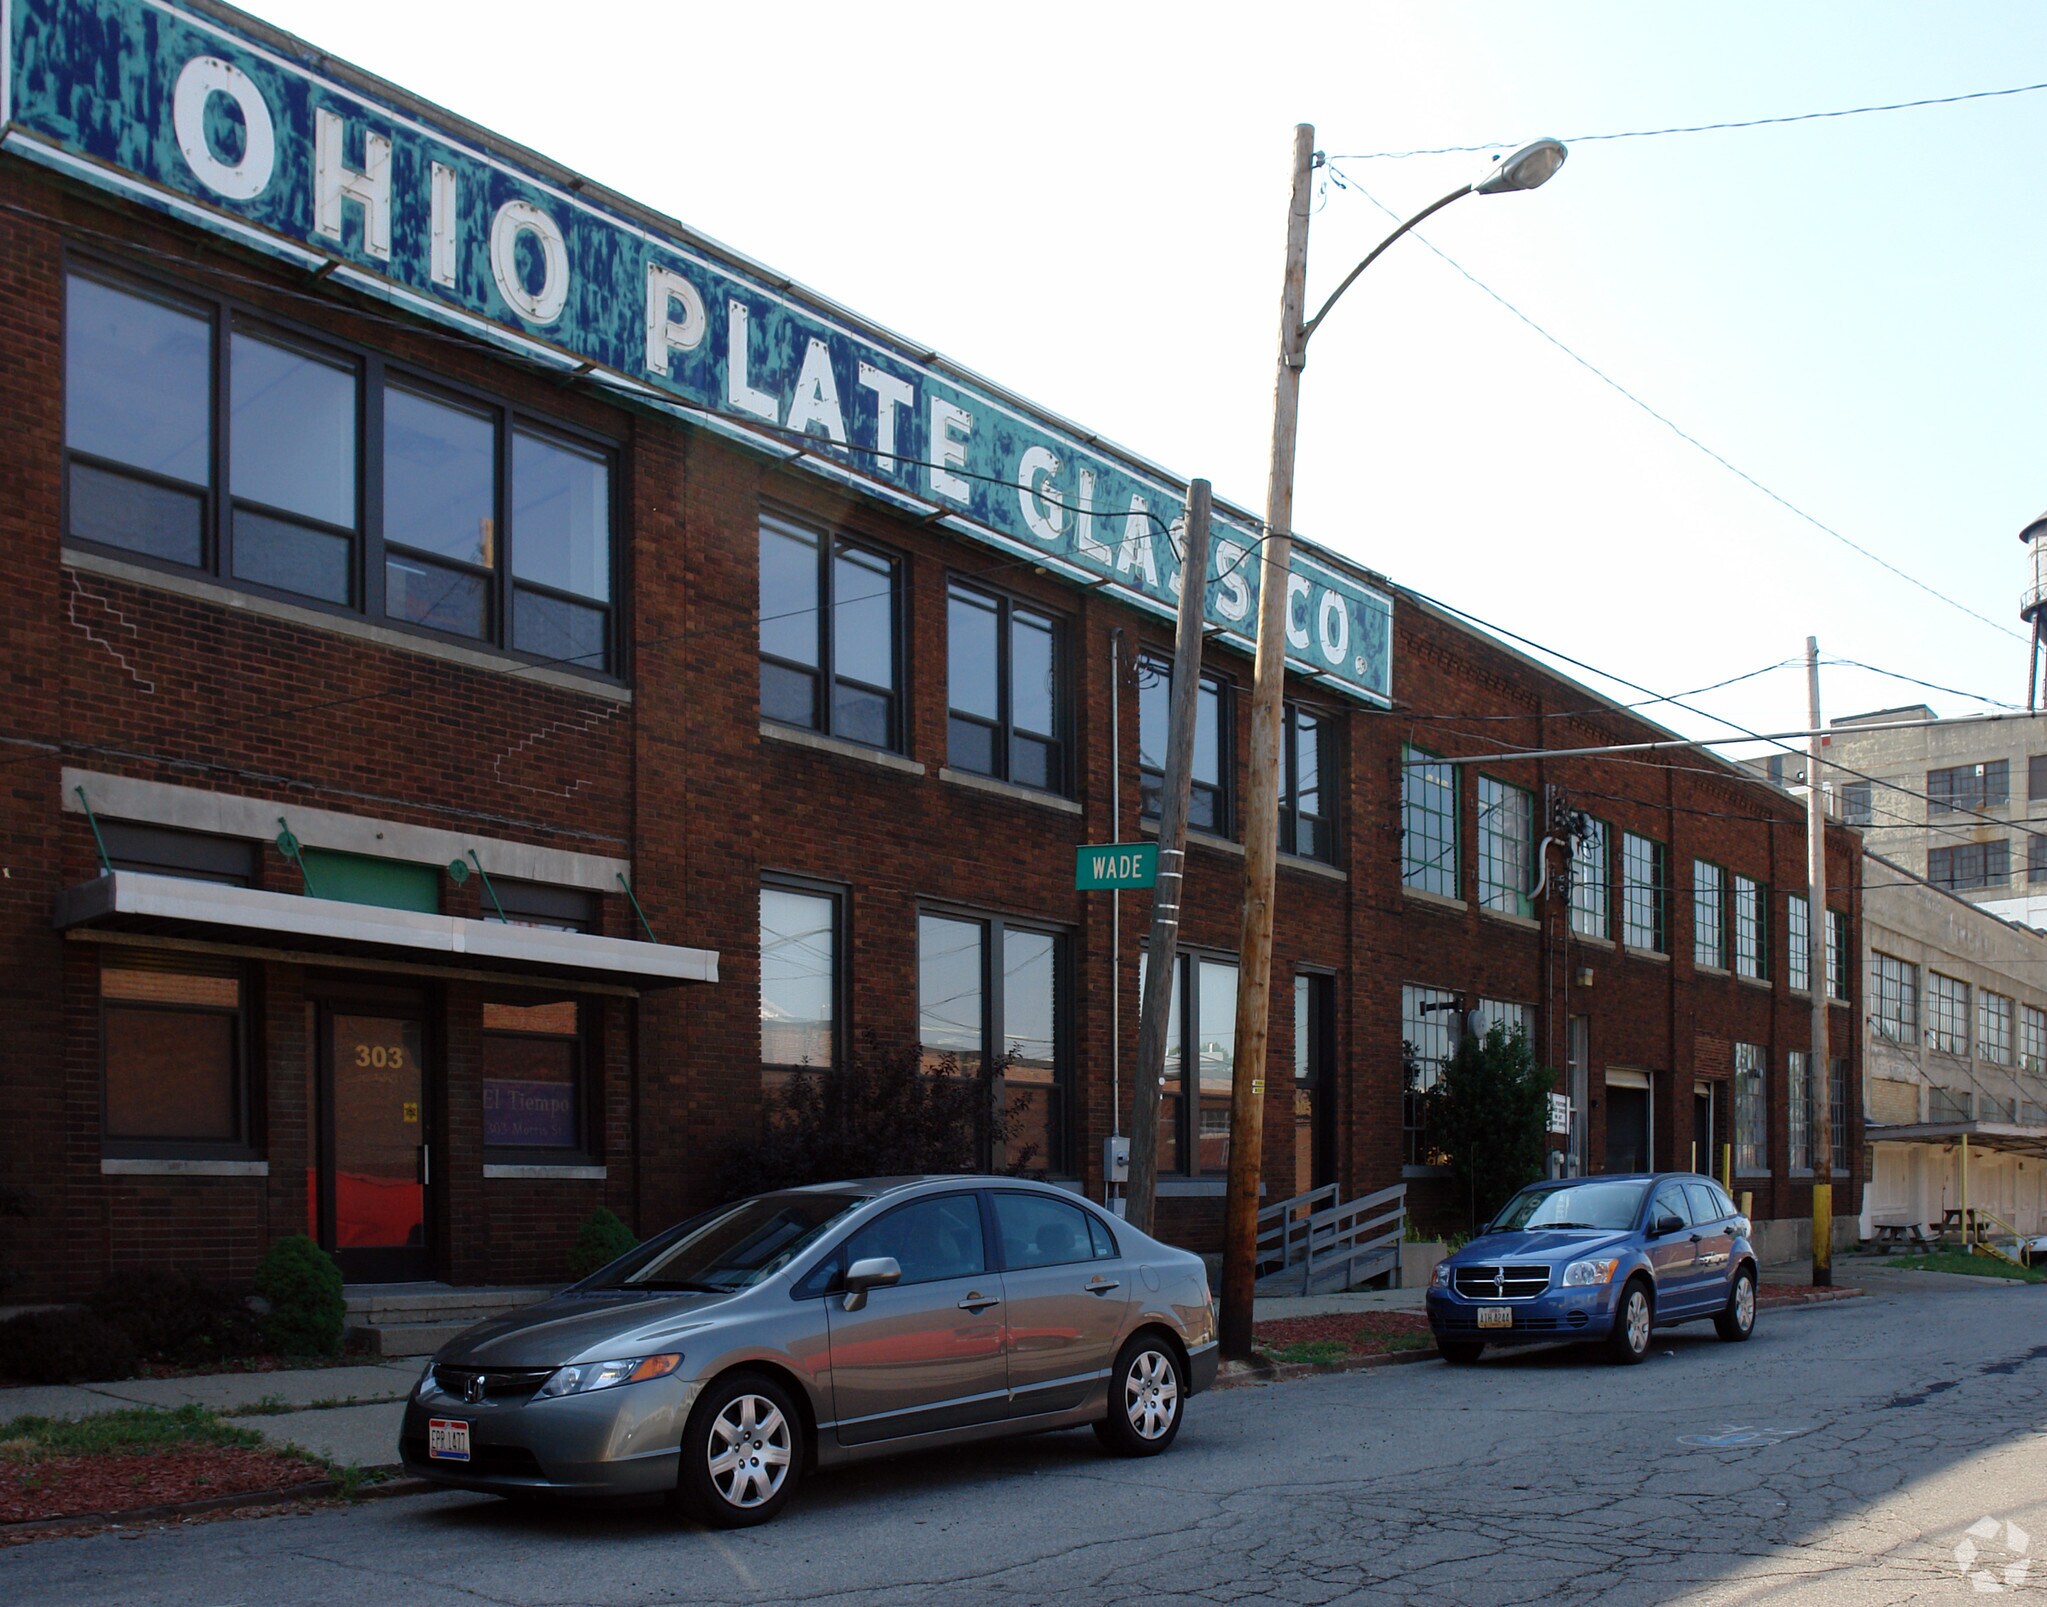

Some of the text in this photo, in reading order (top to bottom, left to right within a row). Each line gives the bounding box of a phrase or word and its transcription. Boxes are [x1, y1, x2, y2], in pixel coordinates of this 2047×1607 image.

[173, 55, 570, 324] OHIO
[646, 260, 973, 506] PLATE
[1286, 572, 1368, 676] CO.
[1092, 854, 1143, 880] WADE
[354, 1044, 403, 1069] 303
[483, 1088, 569, 1119] El Tiempo
